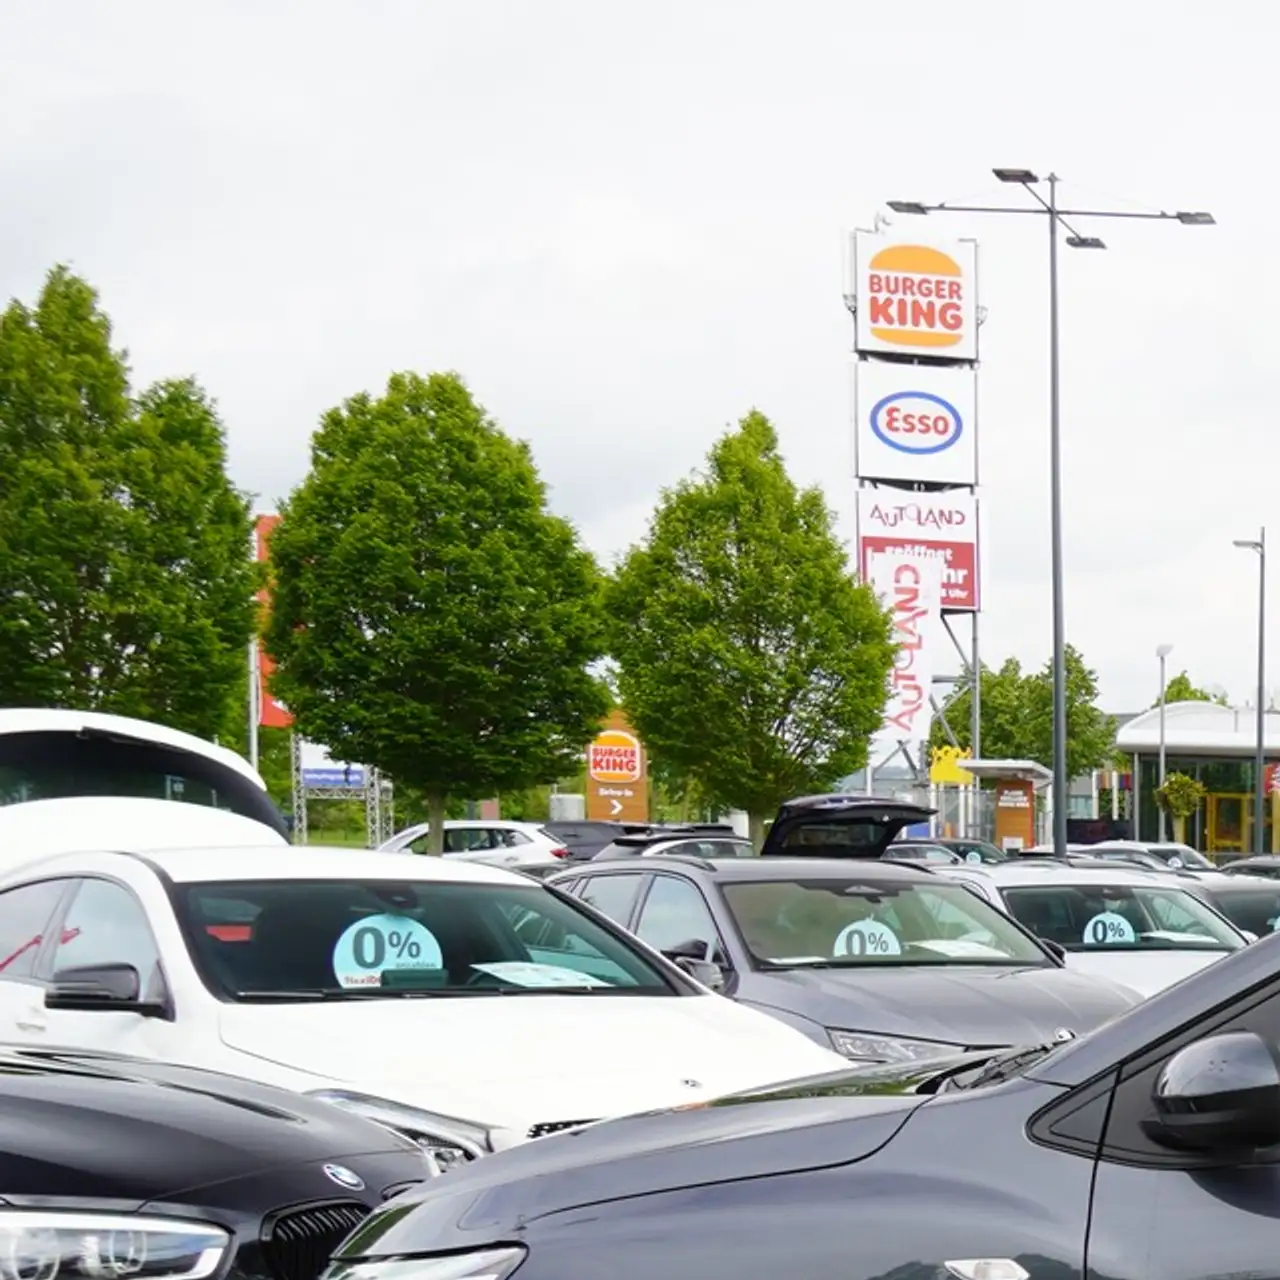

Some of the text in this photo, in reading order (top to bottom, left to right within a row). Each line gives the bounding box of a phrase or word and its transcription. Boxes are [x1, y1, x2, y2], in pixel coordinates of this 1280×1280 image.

[869, 273, 963, 301] BURGER
[869, 297, 964, 331] KING
[870, 503, 966, 531] AUTOLAND
[592, 747, 637, 759] BURGER
[592, 759, 637, 772] KING
[845, 928, 890, 956] 0%
[1091, 919, 1126, 944] 0%
[353, 926, 421, 970] 0%
